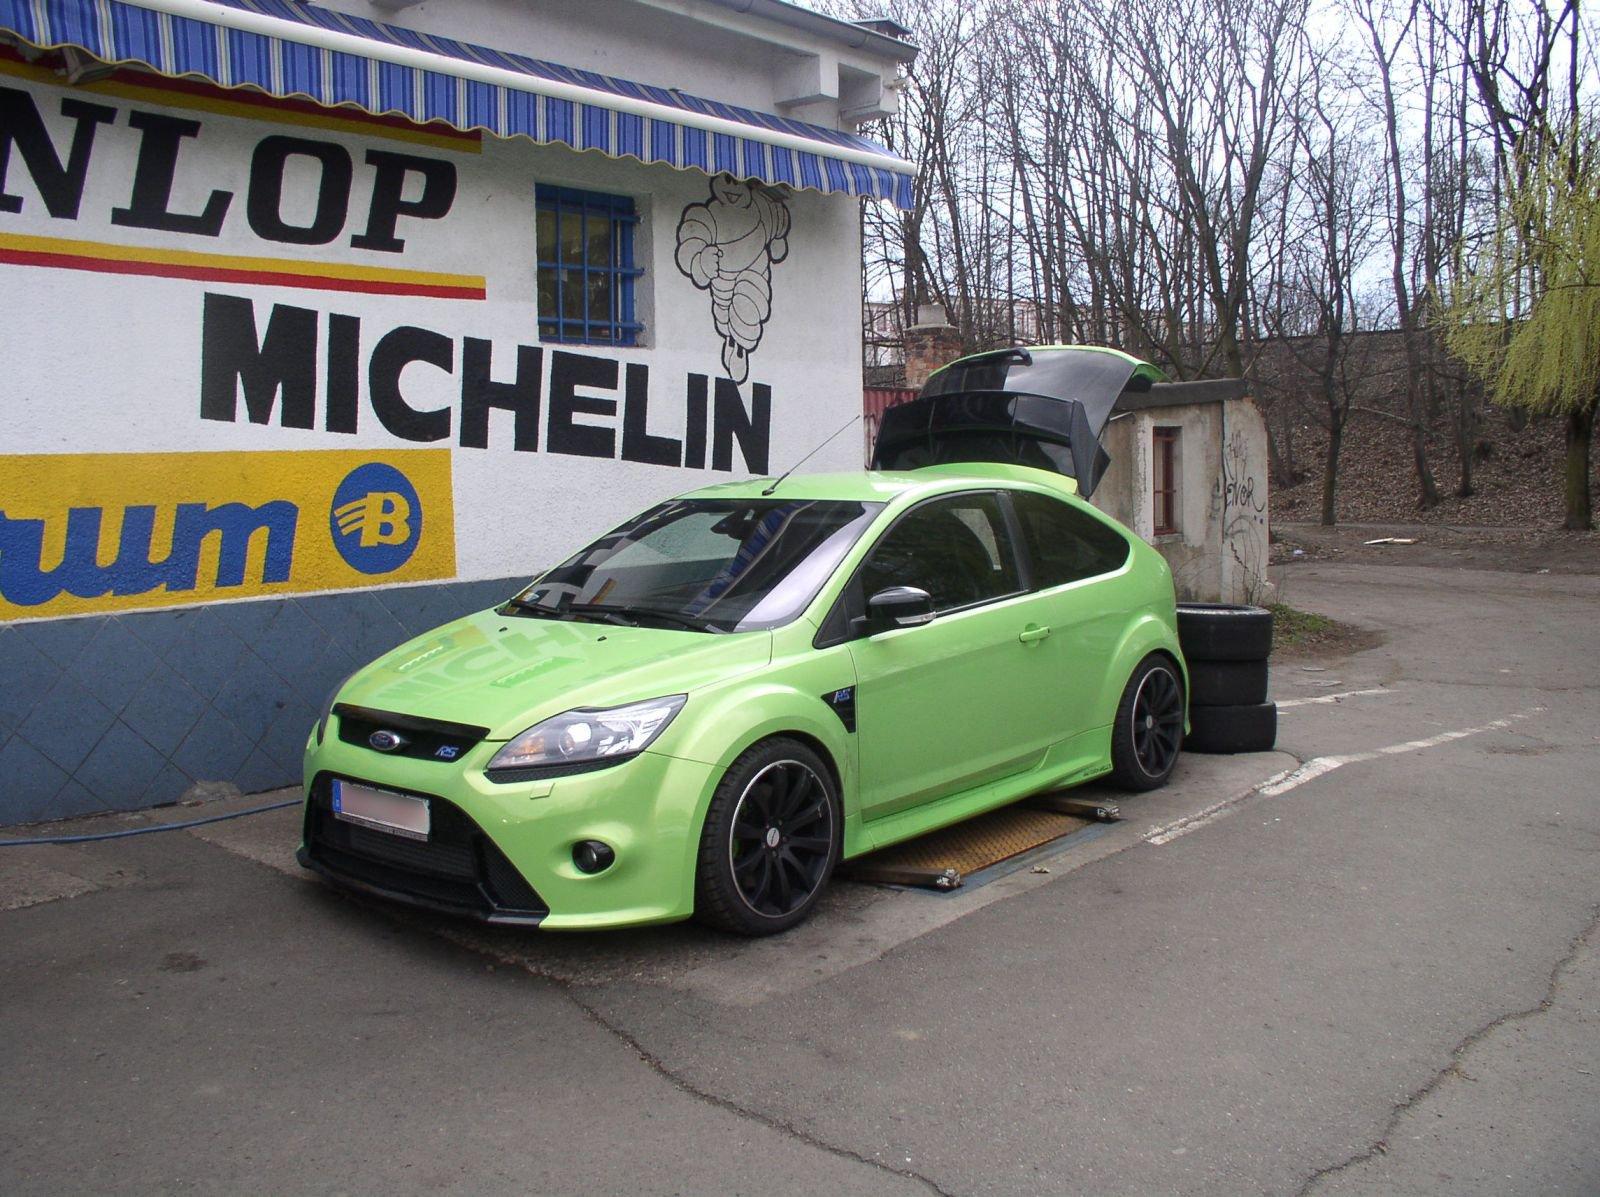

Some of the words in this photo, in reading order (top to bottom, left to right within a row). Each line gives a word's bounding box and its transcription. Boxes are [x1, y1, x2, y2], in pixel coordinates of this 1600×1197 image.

[0, 86, 458, 253] NLOP
[200, 291, 772, 475] MICHELIN
[435, 745, 460, 758] RS
